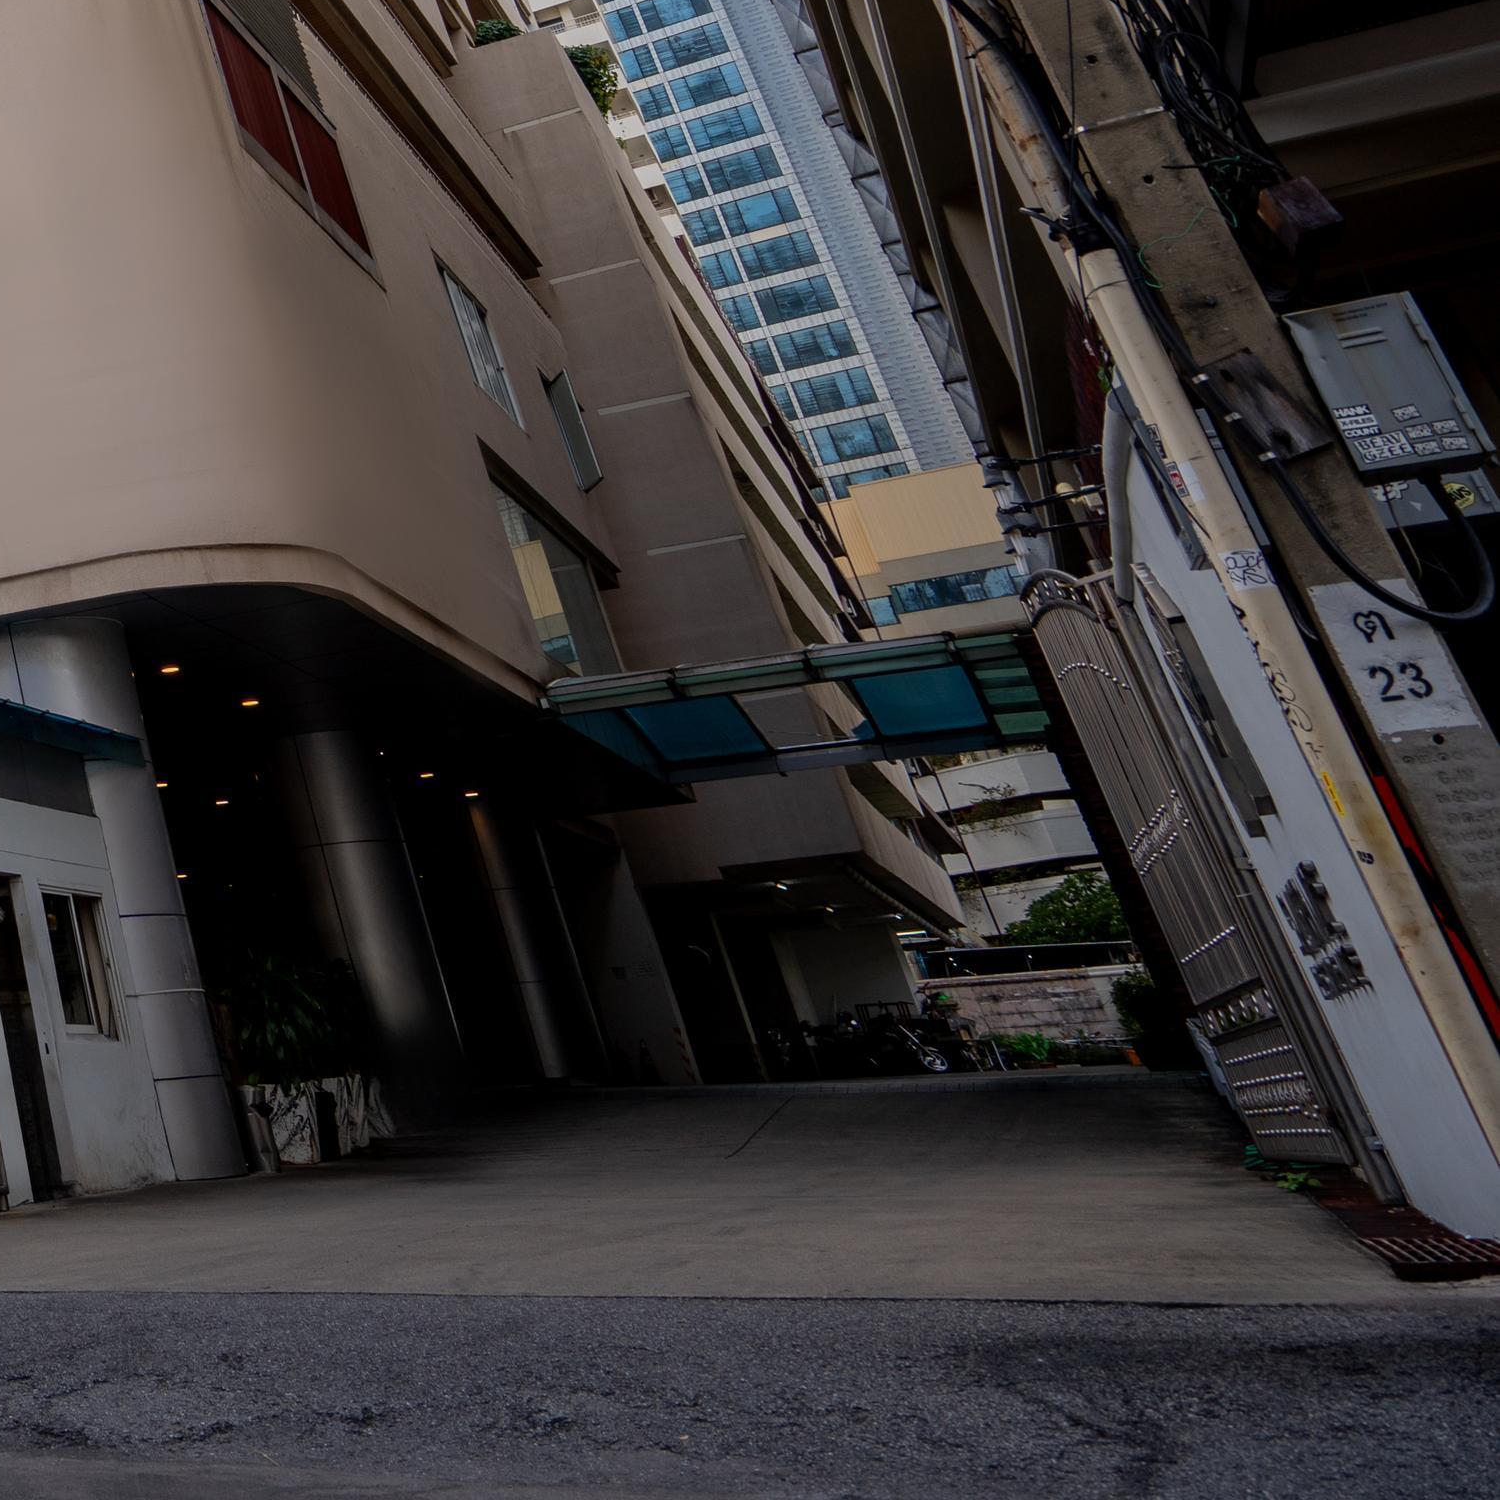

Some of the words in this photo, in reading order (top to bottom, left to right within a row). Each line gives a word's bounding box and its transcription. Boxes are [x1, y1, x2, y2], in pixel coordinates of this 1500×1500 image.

[1333, 405, 1370, 418] HANK
[1340, 416, 1375, 428] X-FILES
[1344, 426, 1381, 438] COUNT
[1368, 662, 1434, 702] 23
